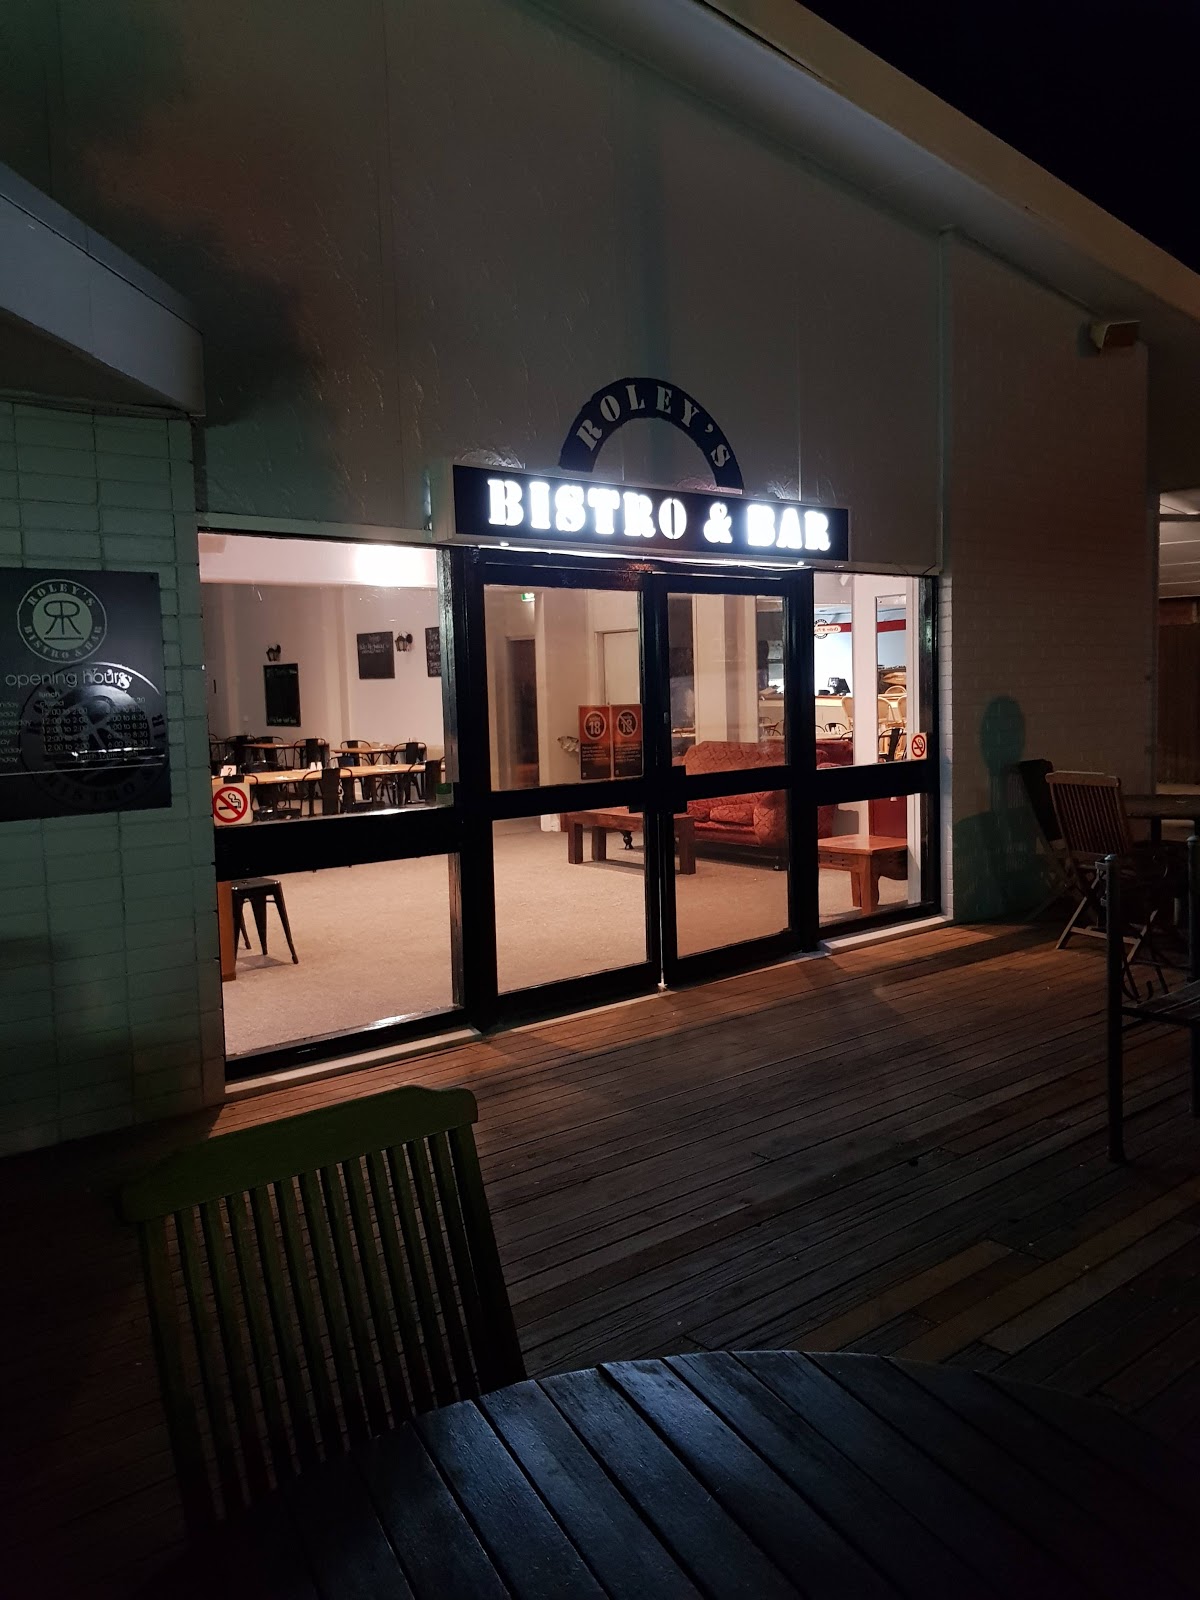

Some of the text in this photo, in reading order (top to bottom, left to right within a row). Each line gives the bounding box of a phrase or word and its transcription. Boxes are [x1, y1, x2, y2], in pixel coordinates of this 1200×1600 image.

[576, 384, 731, 468] ROLEY'S
[487, 478, 831, 552] BISTRO & BAR
[27, 583, 95, 607] ROLEY'S
[5, 671, 78, 688] opening
[588, 721, 601, 735] 18
